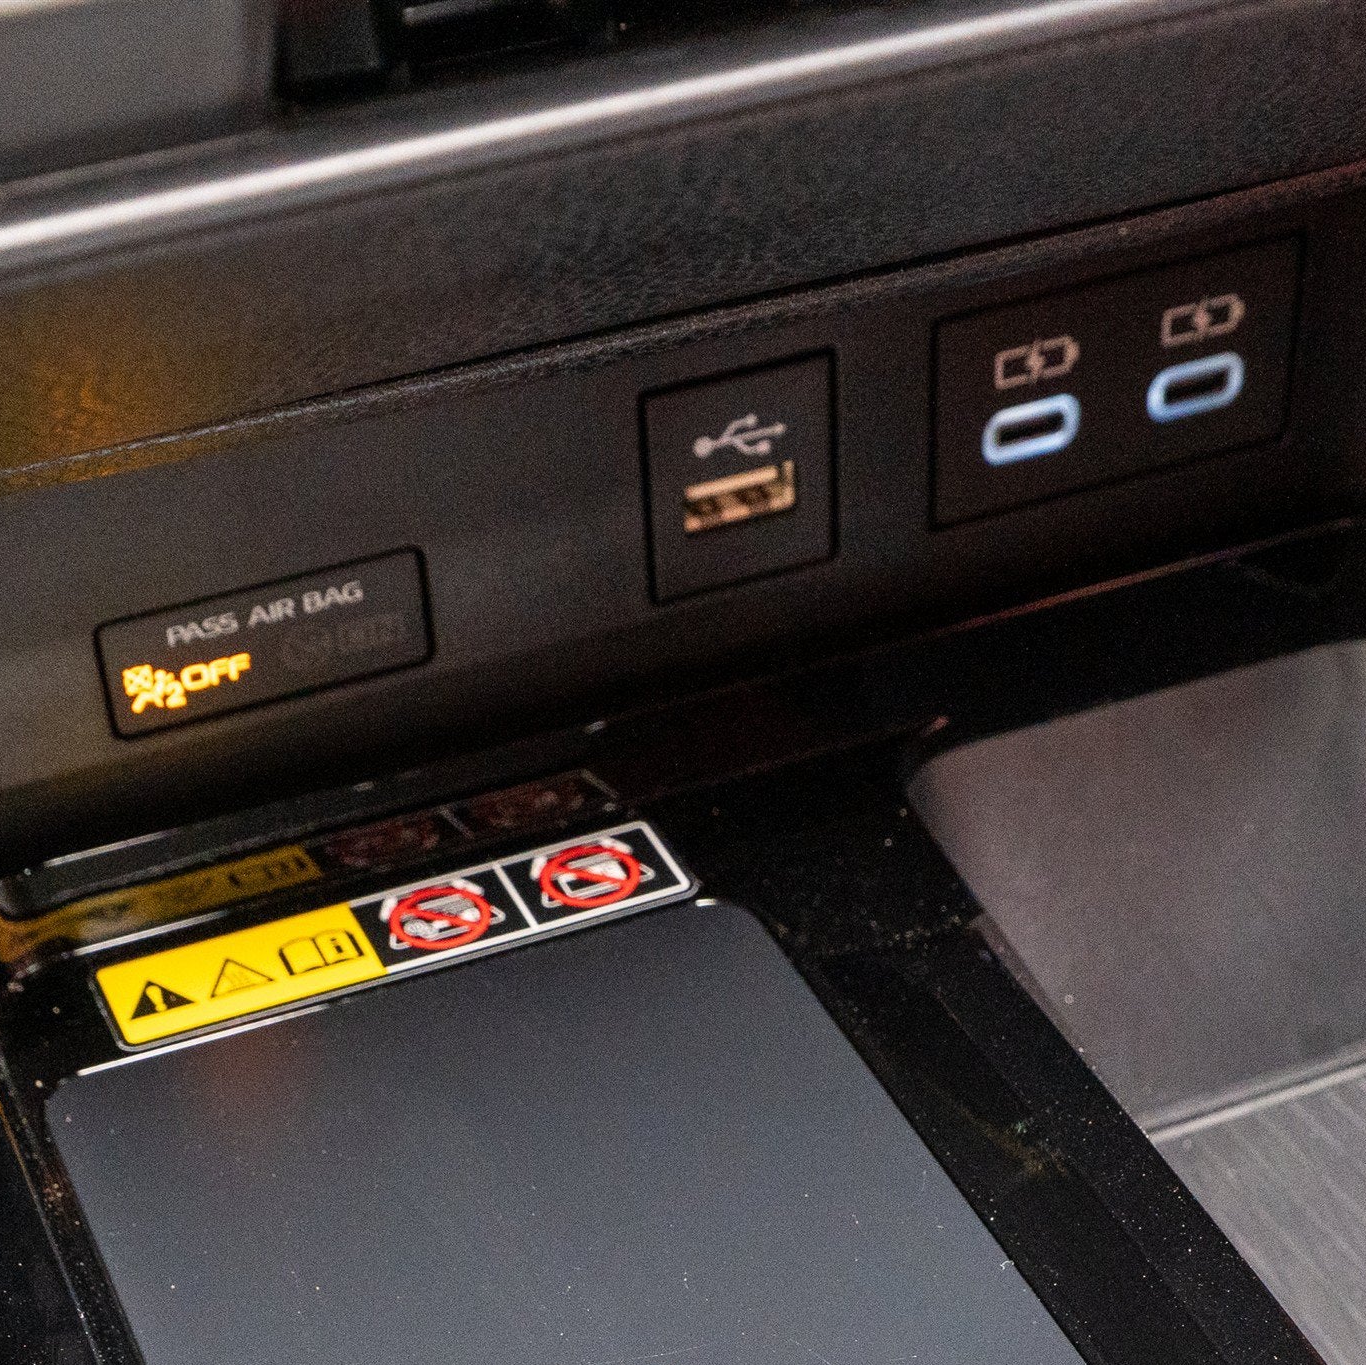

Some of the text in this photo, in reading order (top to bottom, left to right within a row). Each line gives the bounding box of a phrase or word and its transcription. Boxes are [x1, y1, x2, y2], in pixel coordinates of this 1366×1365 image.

[166, 580, 364, 648] PASS AIR BAG
[180, 652, 251, 692] OFF
